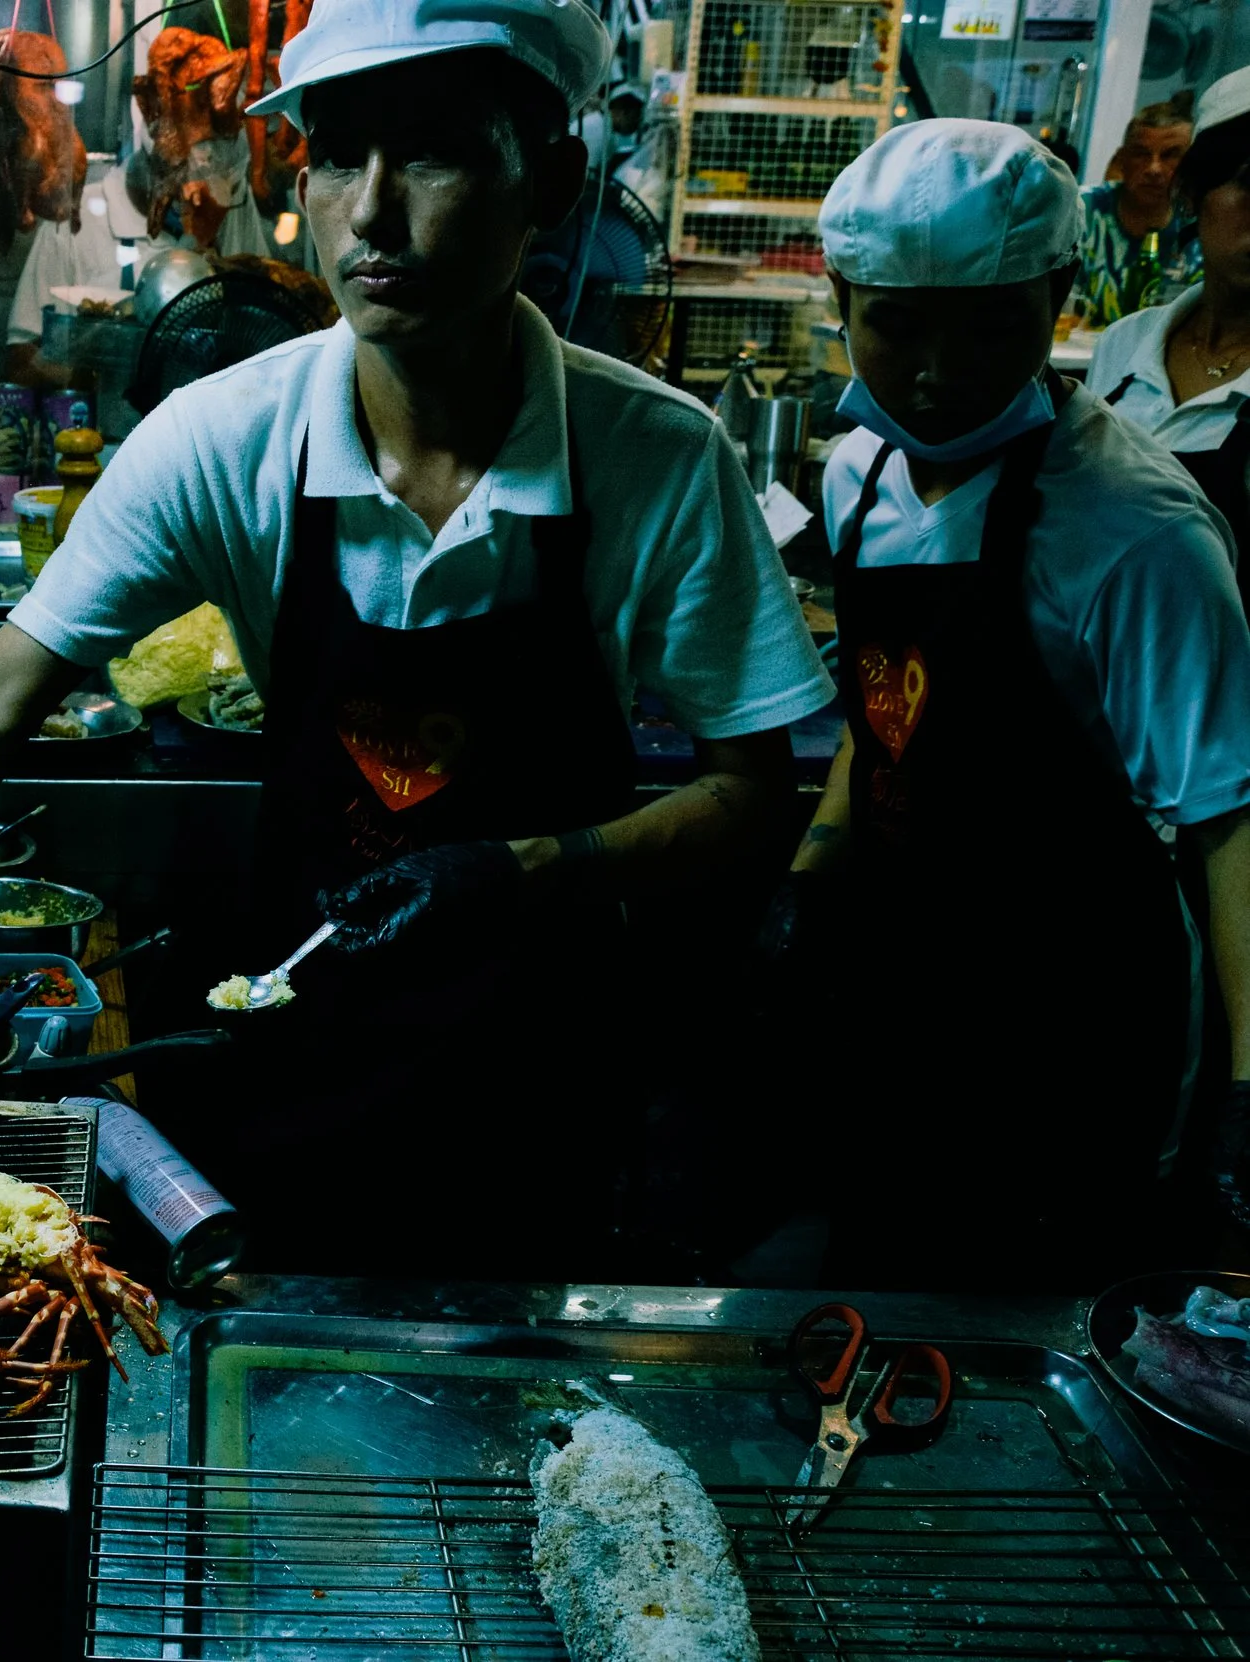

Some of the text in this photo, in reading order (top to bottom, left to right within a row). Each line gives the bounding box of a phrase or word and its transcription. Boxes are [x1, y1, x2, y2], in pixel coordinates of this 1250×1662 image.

[866, 658, 925, 726] LOVE 9
[418, 711, 467, 776] 9
